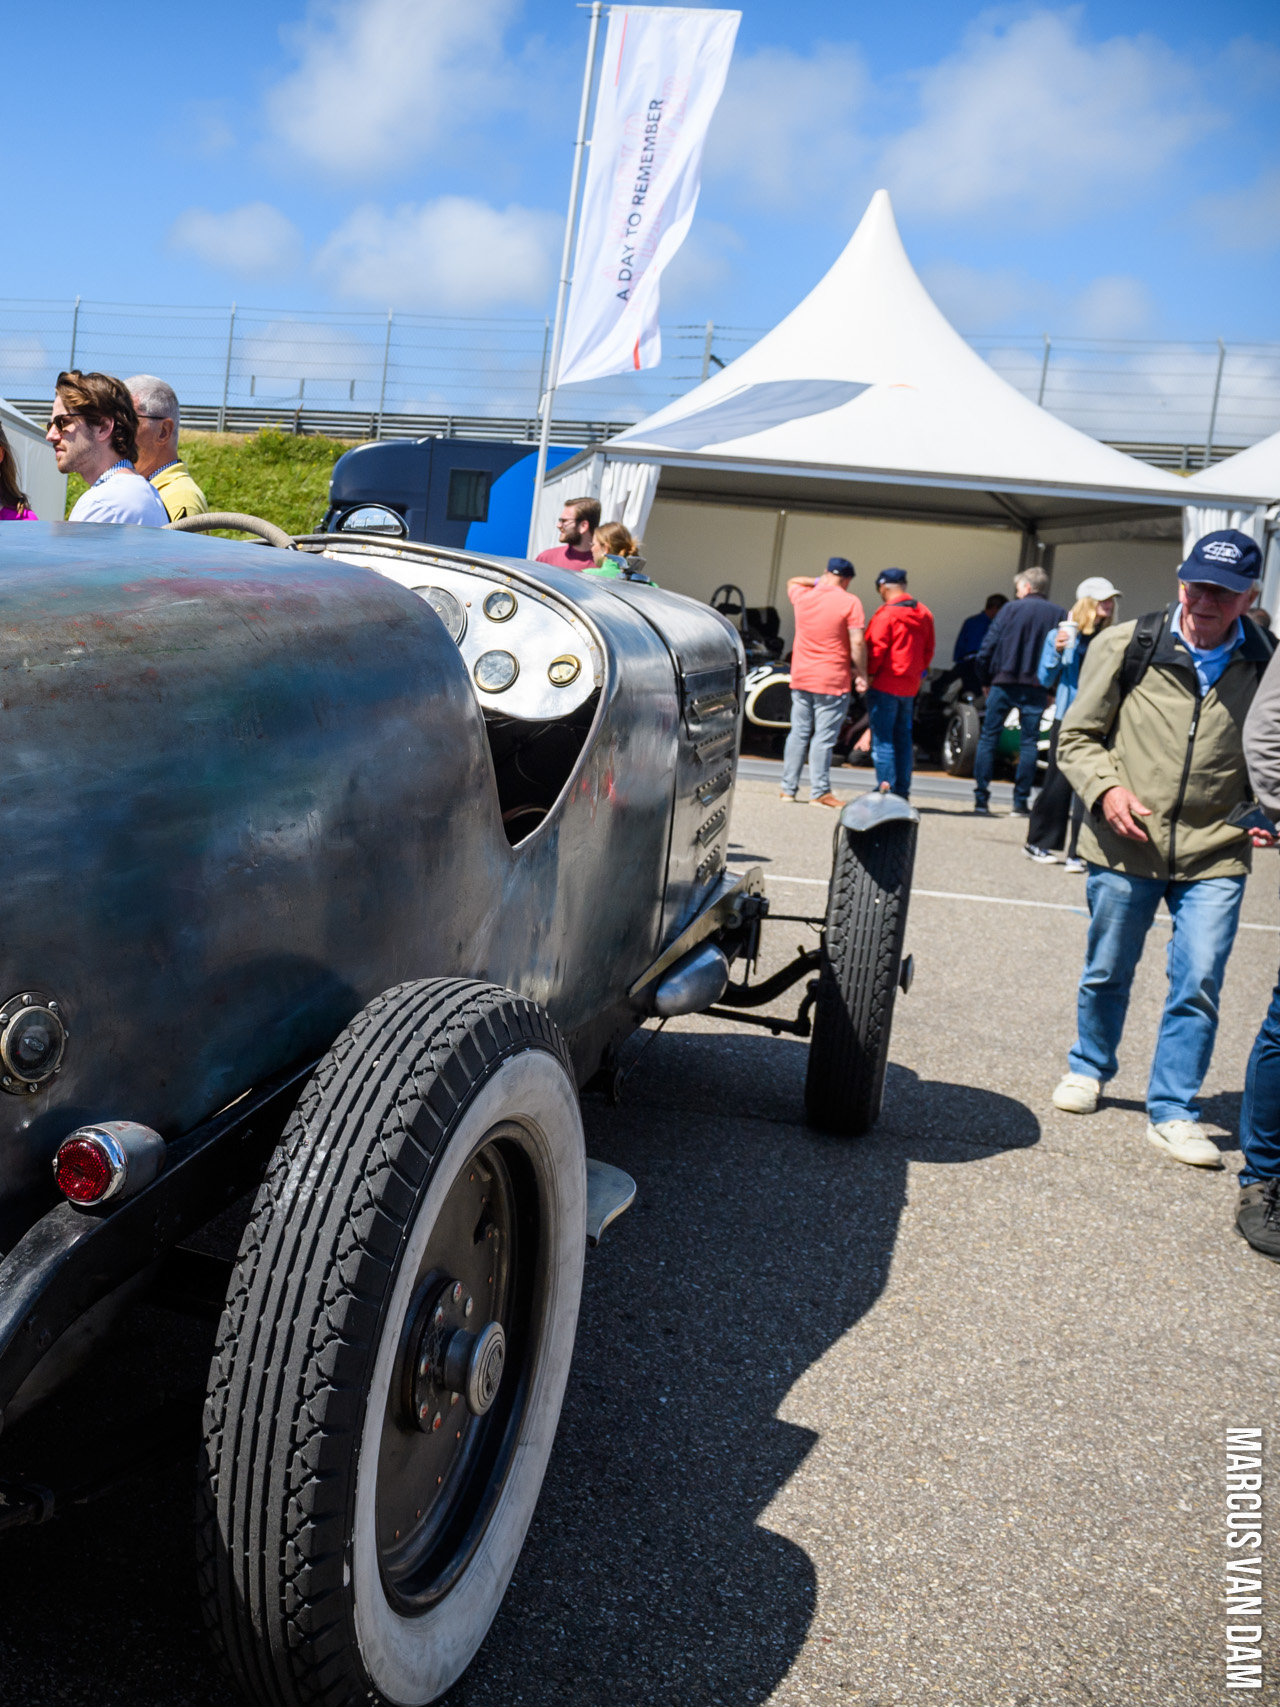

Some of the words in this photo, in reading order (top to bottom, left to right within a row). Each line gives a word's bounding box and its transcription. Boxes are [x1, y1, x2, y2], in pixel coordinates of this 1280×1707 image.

[632, 99, 664, 206] REMEMBER
[626, 212, 642, 237] TO
[618, 244, 635, 282] DAY
[616, 289, 630, 302] A
